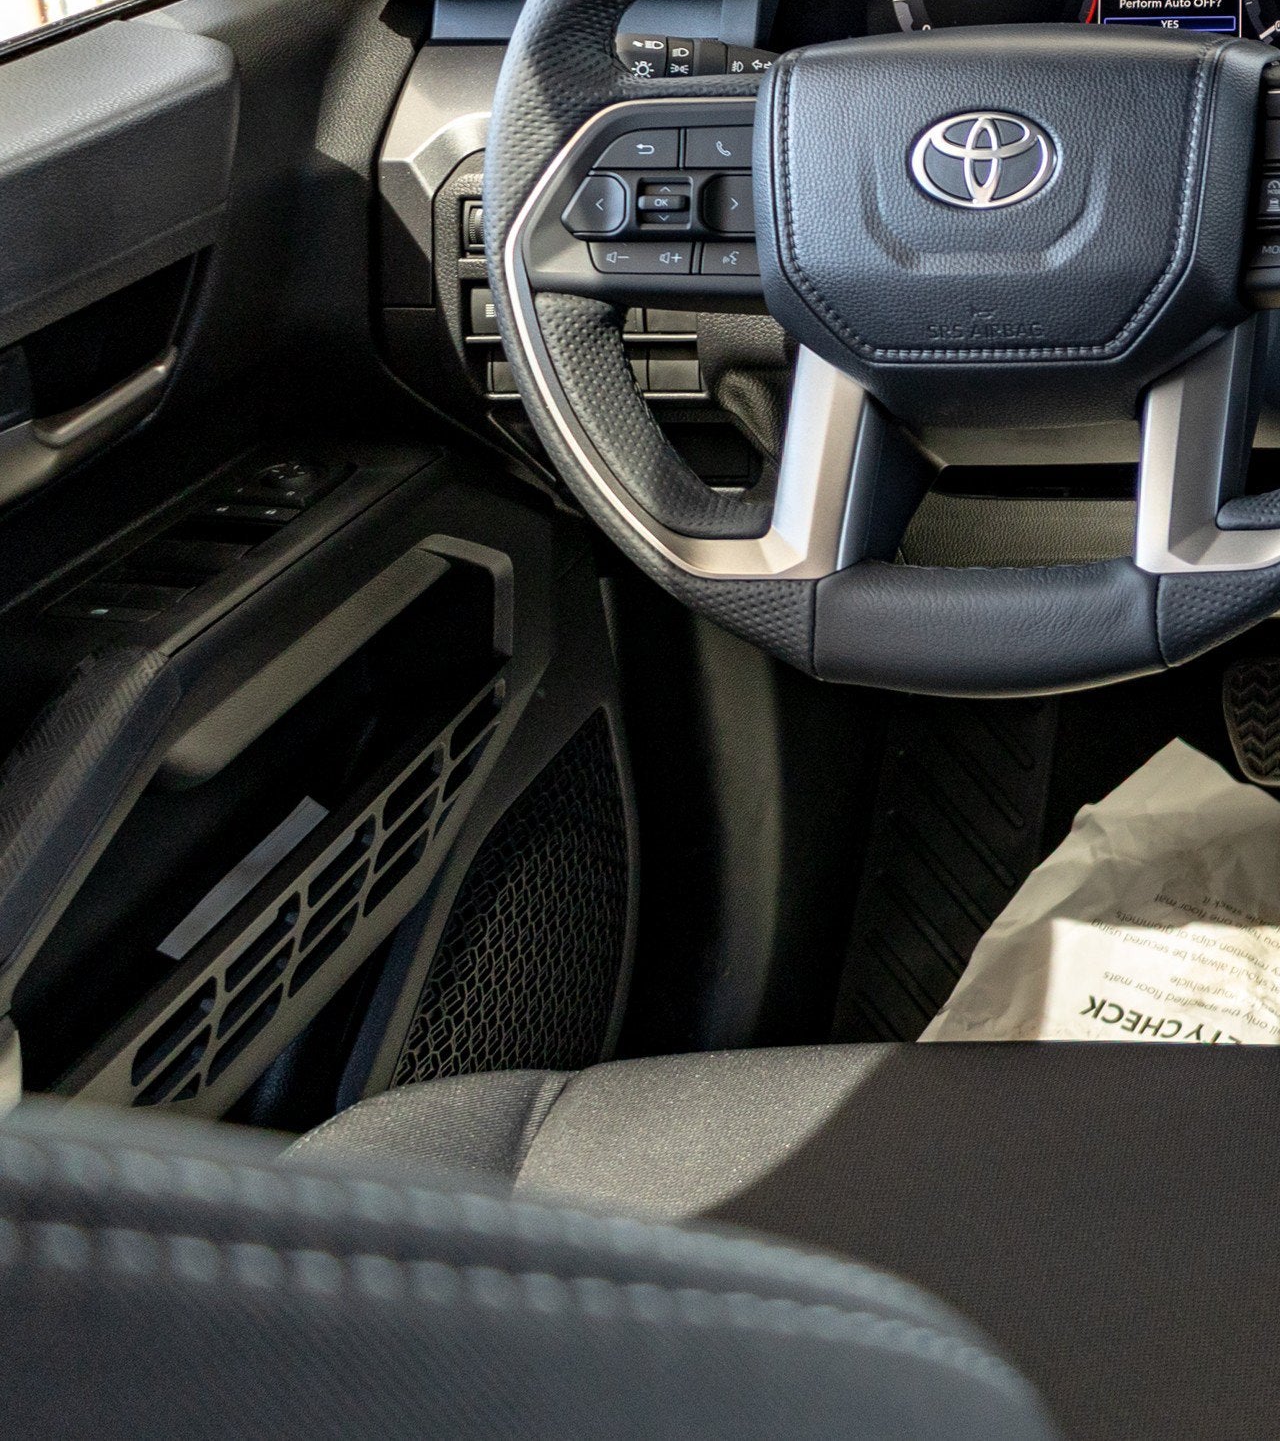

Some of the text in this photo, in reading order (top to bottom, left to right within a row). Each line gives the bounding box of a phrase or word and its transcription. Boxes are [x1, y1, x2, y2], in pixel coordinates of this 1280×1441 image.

[1160, 20, 1180, 29] YES
[654, 198, 669, 208] OK
[1078, 994, 1183, 1040] CHECK
